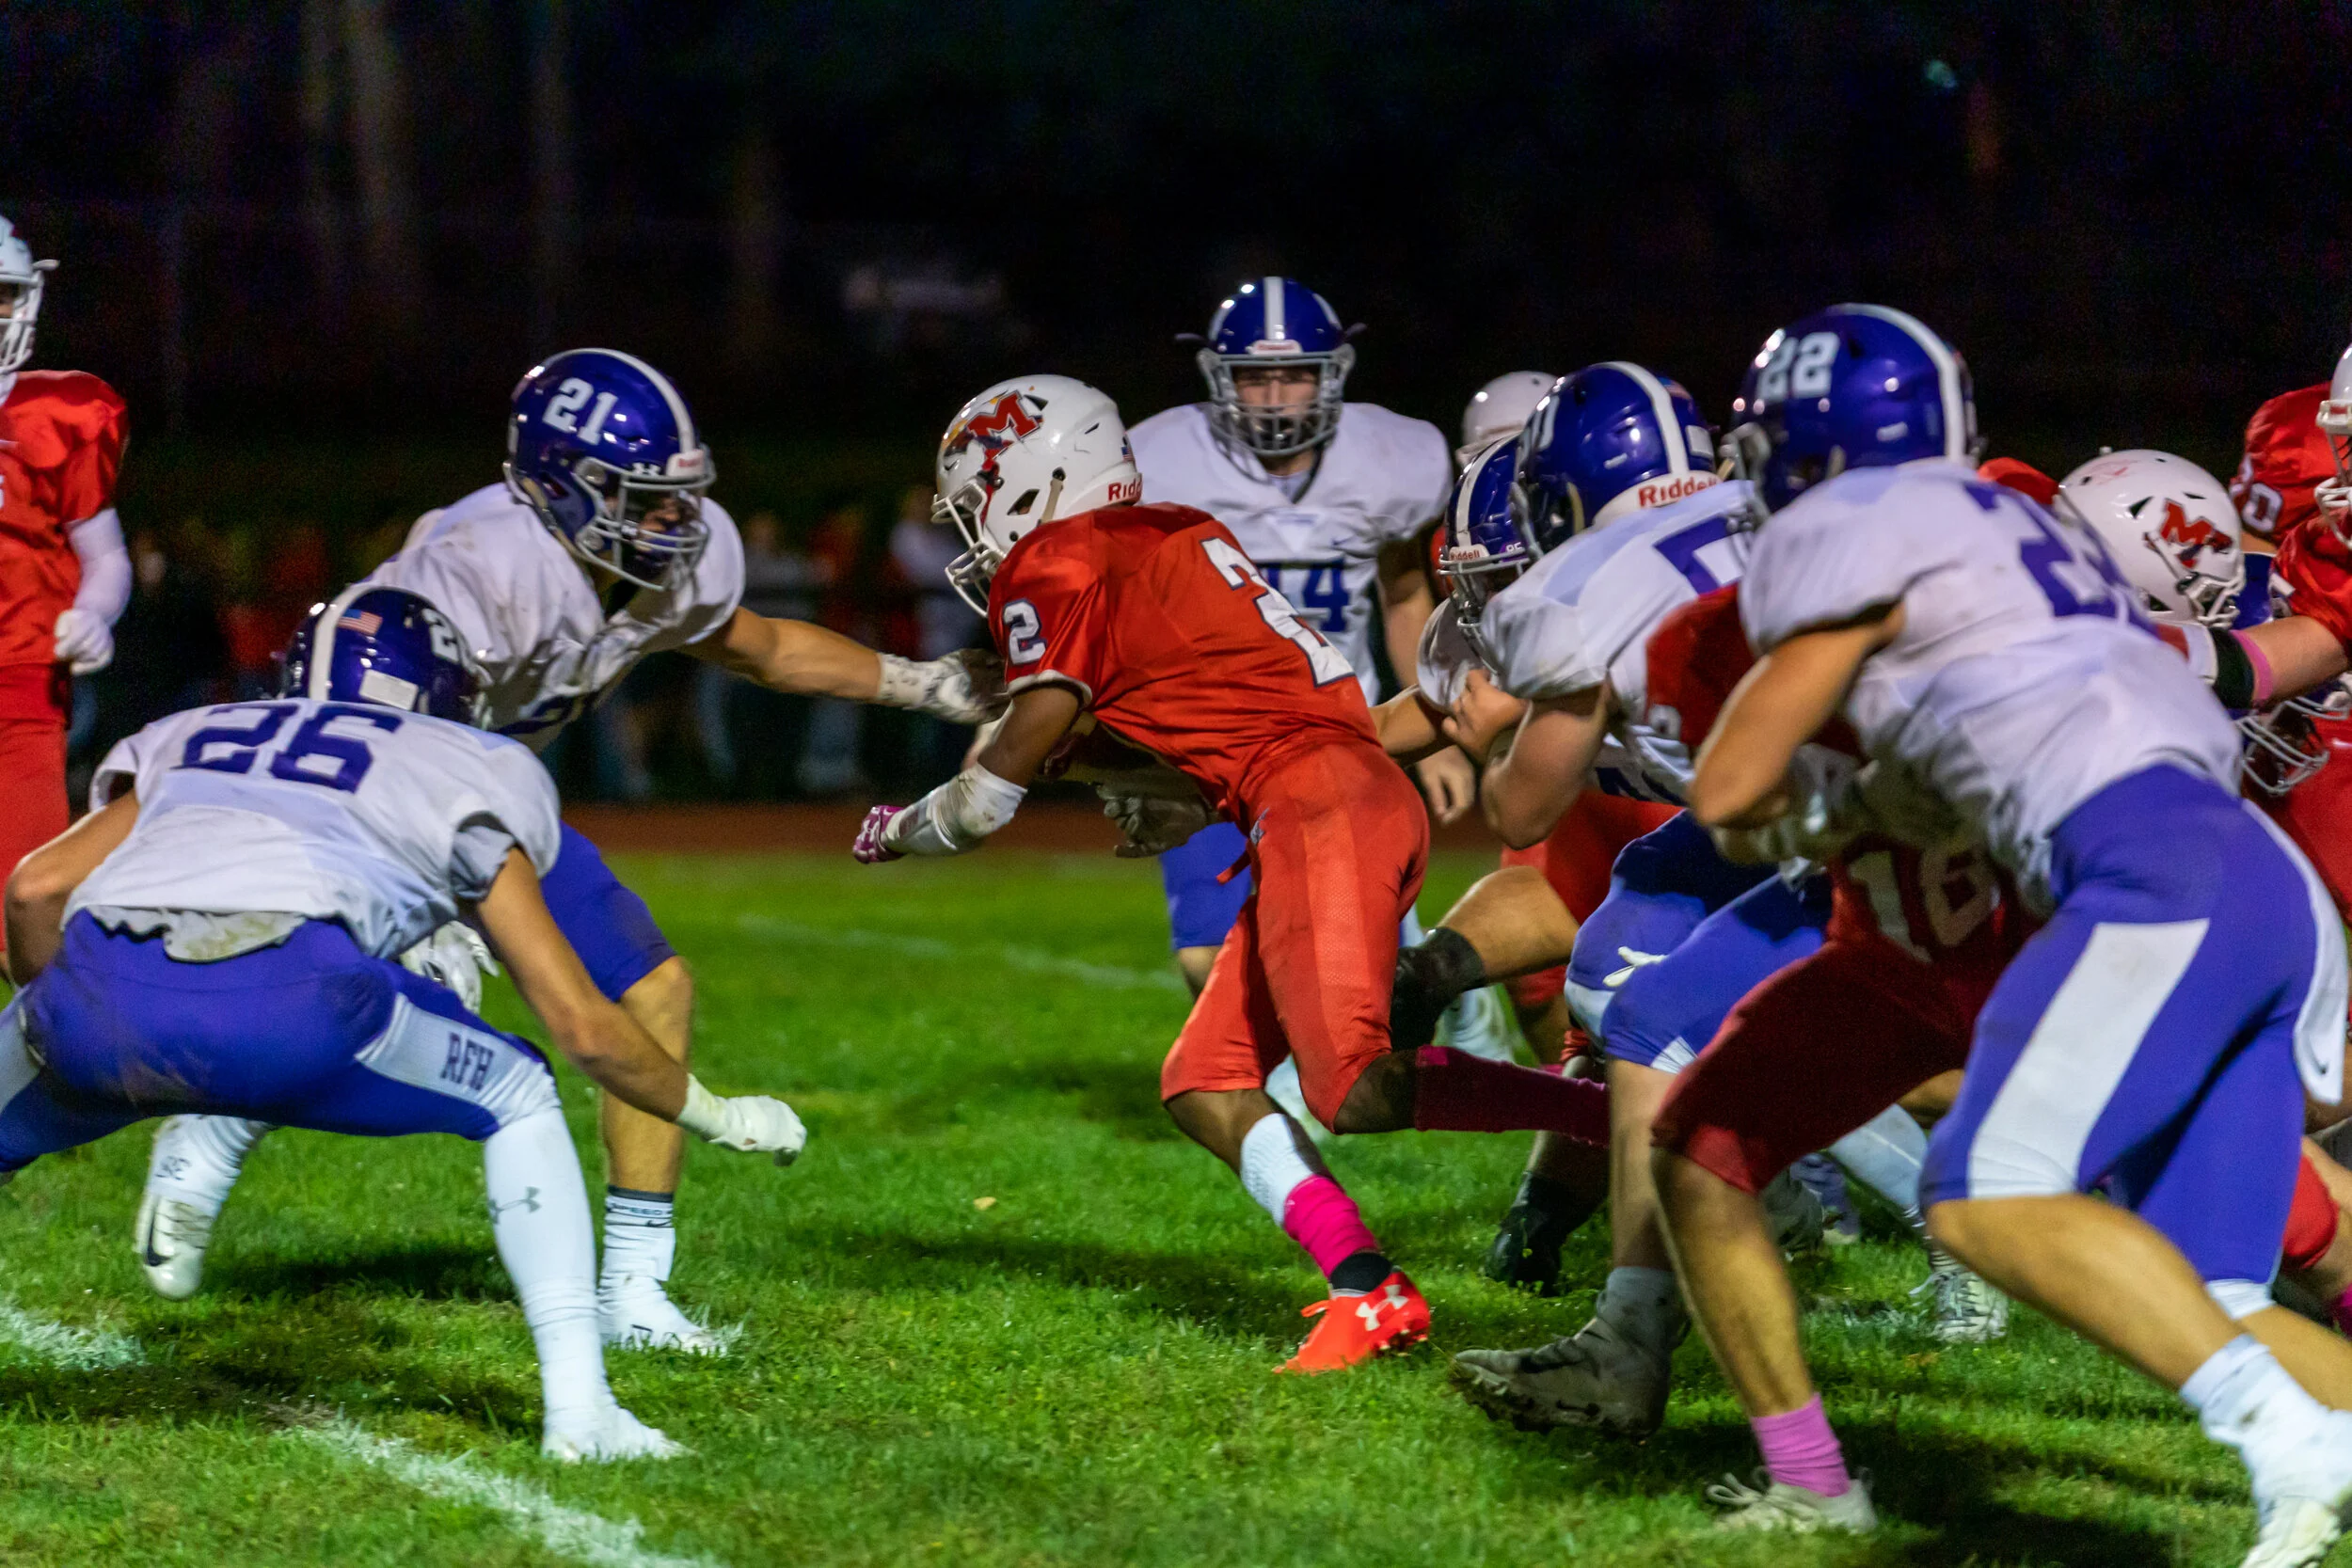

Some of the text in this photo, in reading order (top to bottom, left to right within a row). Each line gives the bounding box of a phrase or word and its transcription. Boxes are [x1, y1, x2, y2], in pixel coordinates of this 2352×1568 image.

[1756, 331, 1840, 402] 22
[542, 377, 619, 445] 21
[965, 389, 1041, 442] M
[1003, 597, 1048, 666] 2
[1199, 536, 1357, 689] 2
[183, 704, 402, 794] 26
[440, 1032, 495, 1091] RFH
